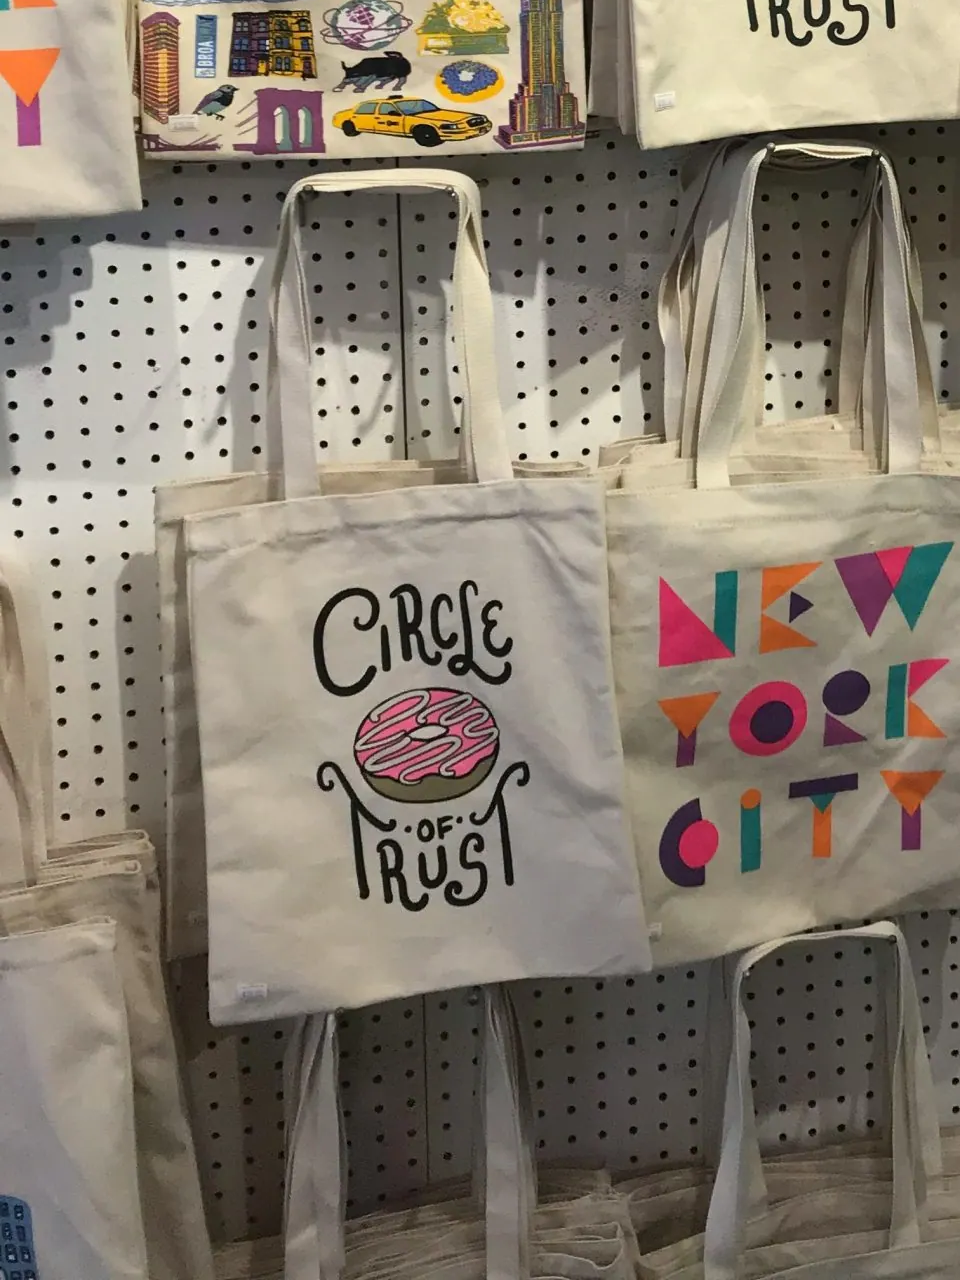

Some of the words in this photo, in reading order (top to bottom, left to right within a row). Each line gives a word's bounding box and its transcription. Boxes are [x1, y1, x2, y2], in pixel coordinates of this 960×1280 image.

[658, 541, 954, 669] NEW
[657, 657, 950, 767] YORK
[416, 815, 454, 843] OF
